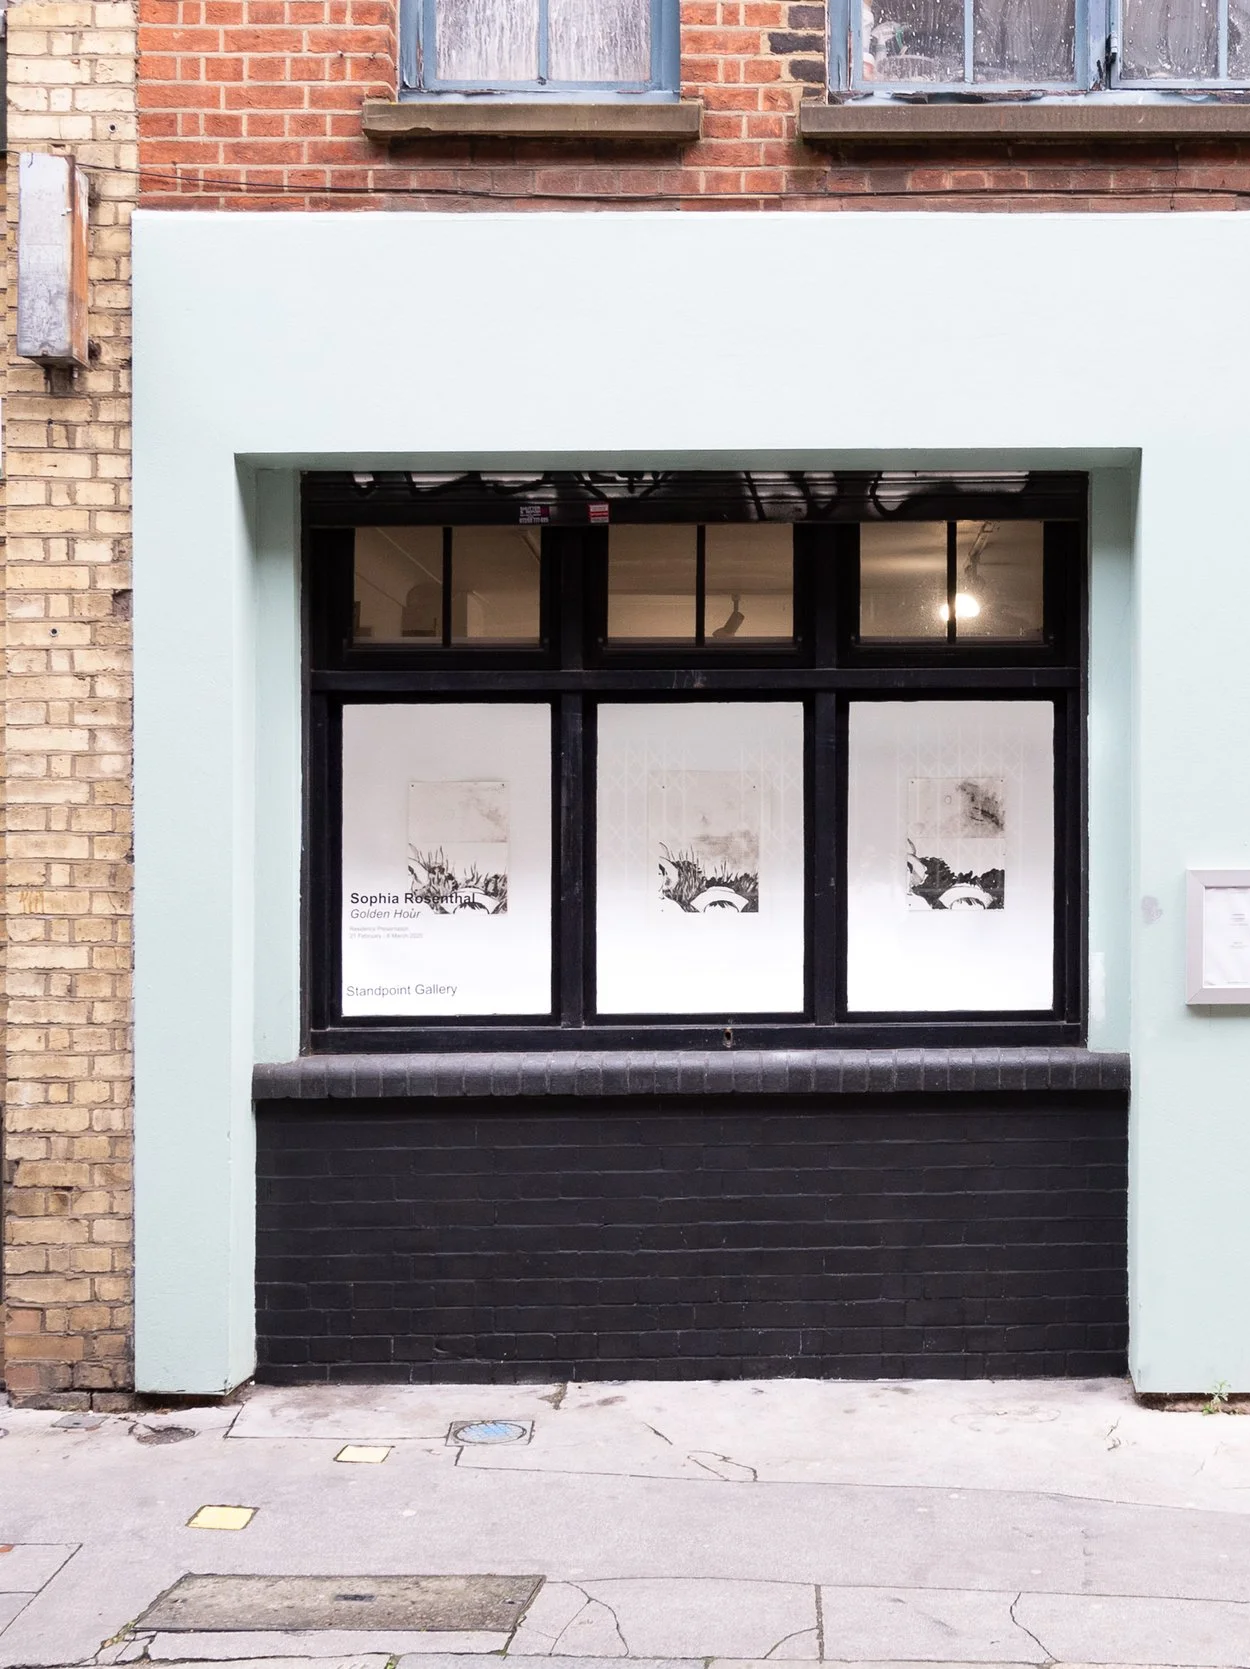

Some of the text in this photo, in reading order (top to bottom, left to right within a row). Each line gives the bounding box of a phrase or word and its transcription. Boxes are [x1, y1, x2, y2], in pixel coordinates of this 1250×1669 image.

[350, 892, 475, 906] Sophia Rosenthal
[350, 909, 421, 919] Golden Hour
[346, 984, 458, 998] Standpoint Gallery
